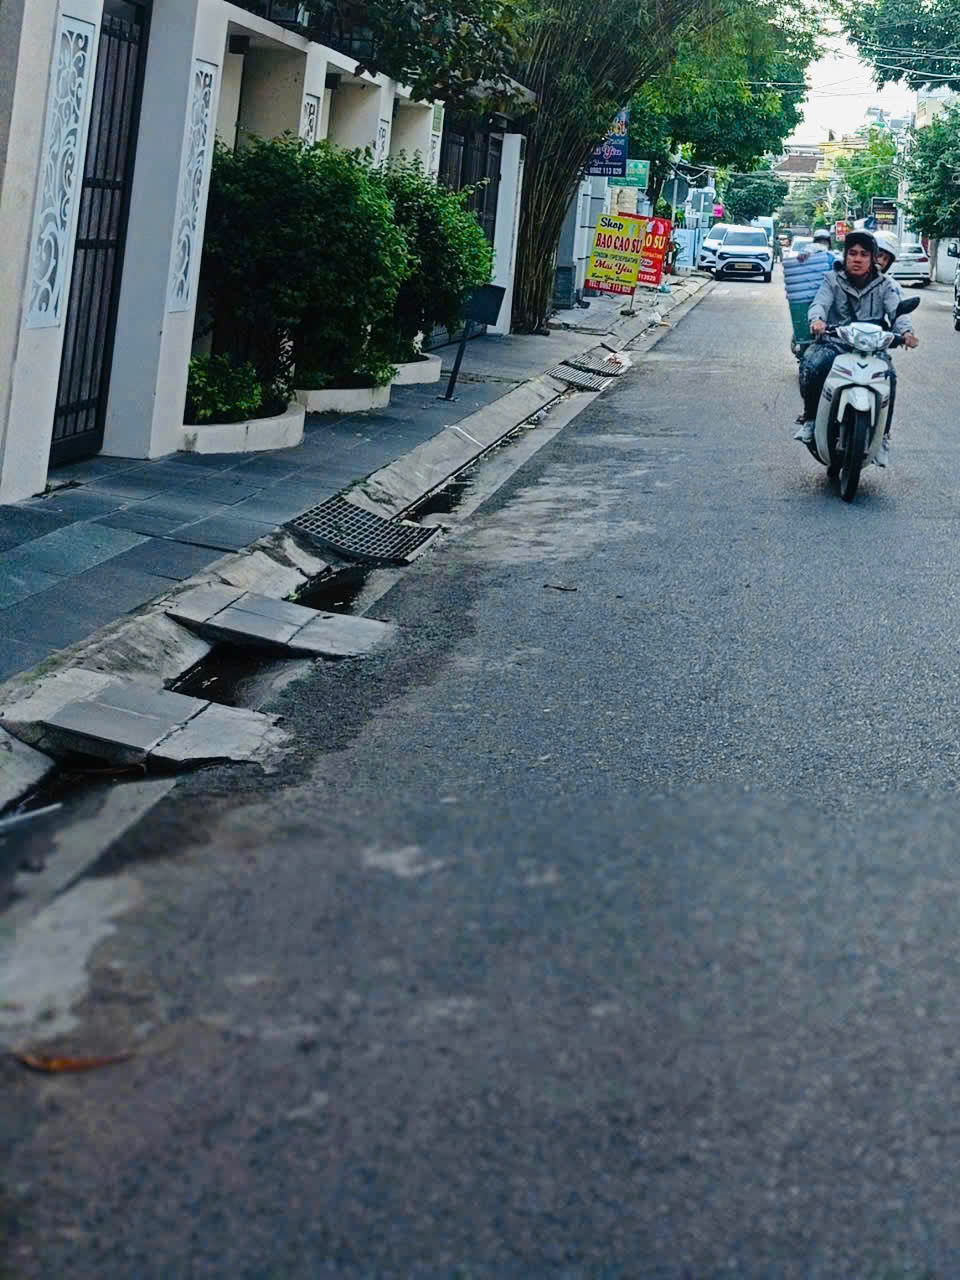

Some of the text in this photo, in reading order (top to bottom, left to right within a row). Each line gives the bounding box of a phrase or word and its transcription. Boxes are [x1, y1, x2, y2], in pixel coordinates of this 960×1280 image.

[600, 217, 623, 231] Shop
[596, 233, 642, 253] BAO CAO SU
[653, 235, 666, 249] SU
